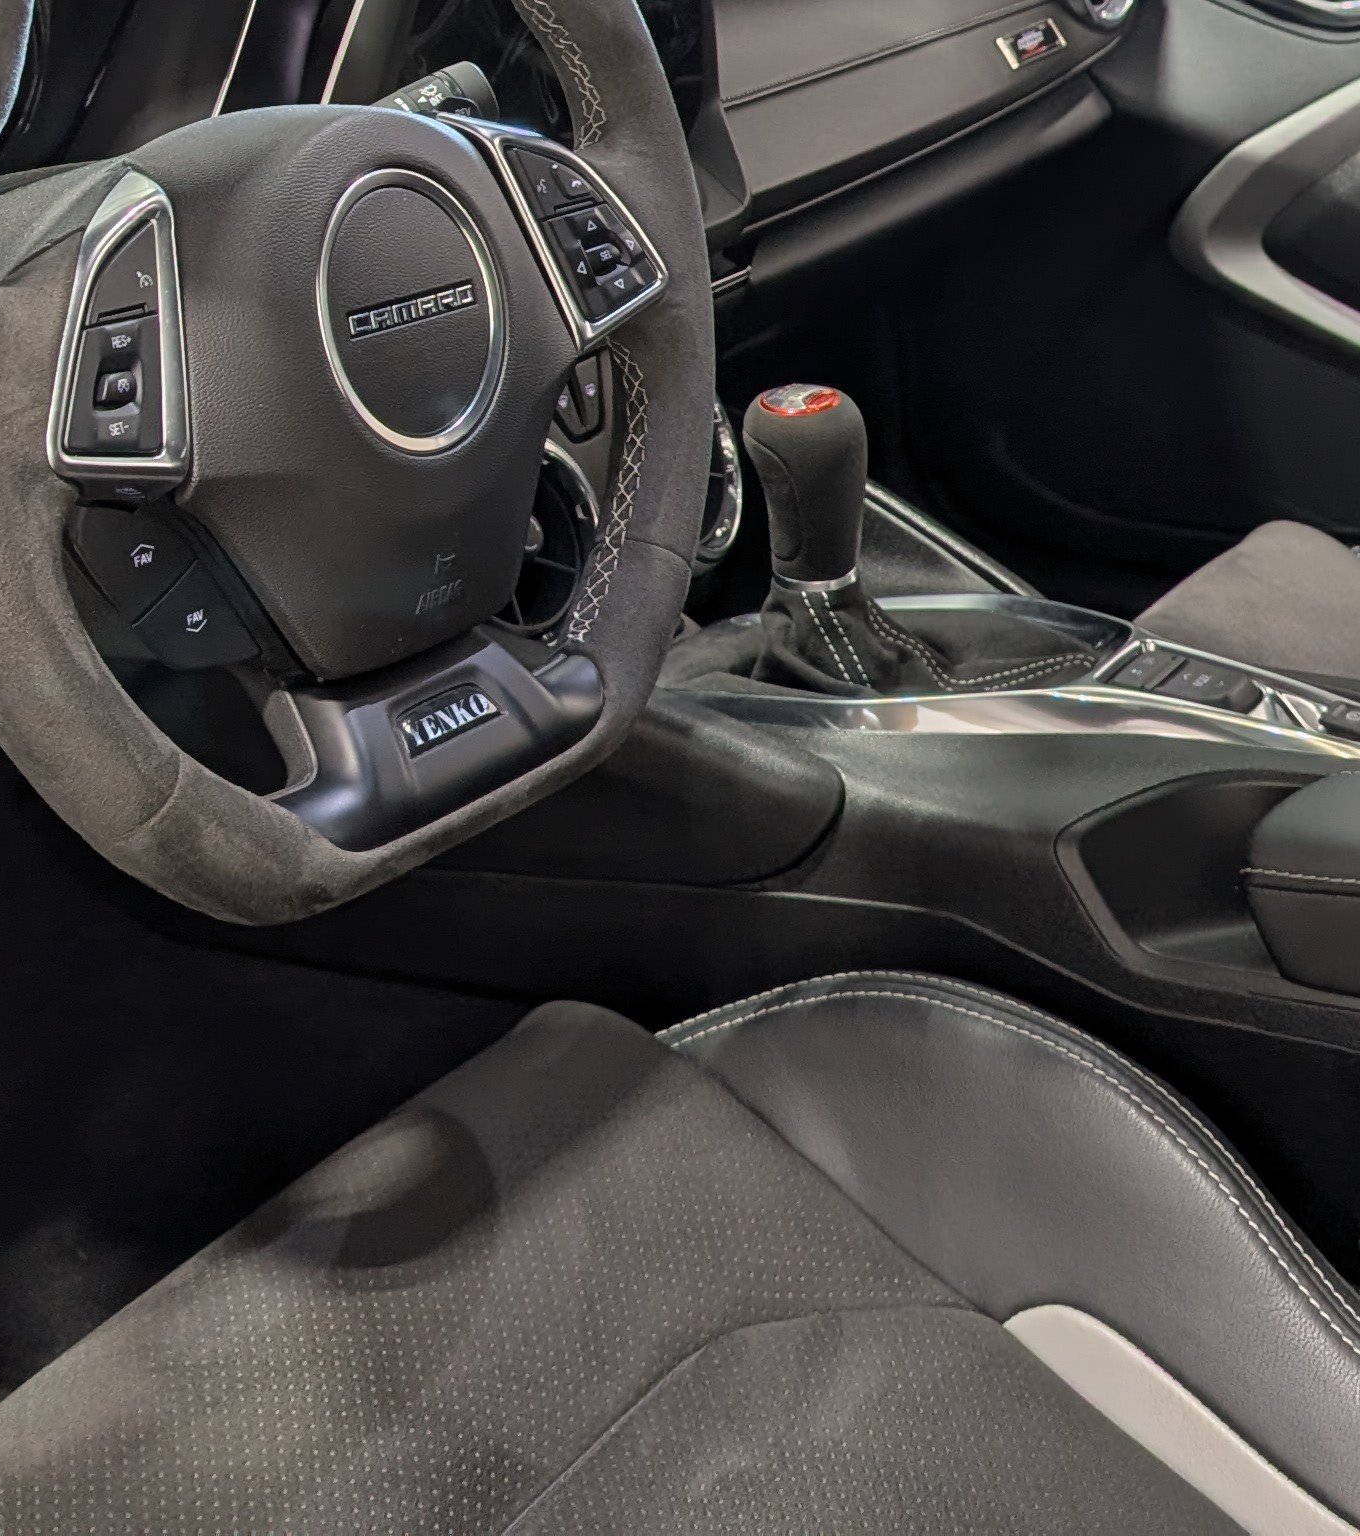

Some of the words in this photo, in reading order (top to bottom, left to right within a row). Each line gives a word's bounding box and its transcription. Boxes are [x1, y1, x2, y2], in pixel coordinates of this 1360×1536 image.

[348, 284, 475, 336] CAMARO
[111, 334, 132, 350] RES+
[133, 550, 153, 568] FAV
[186, 608, 204, 626] FAV
[402, 692, 490, 747] YENKO
